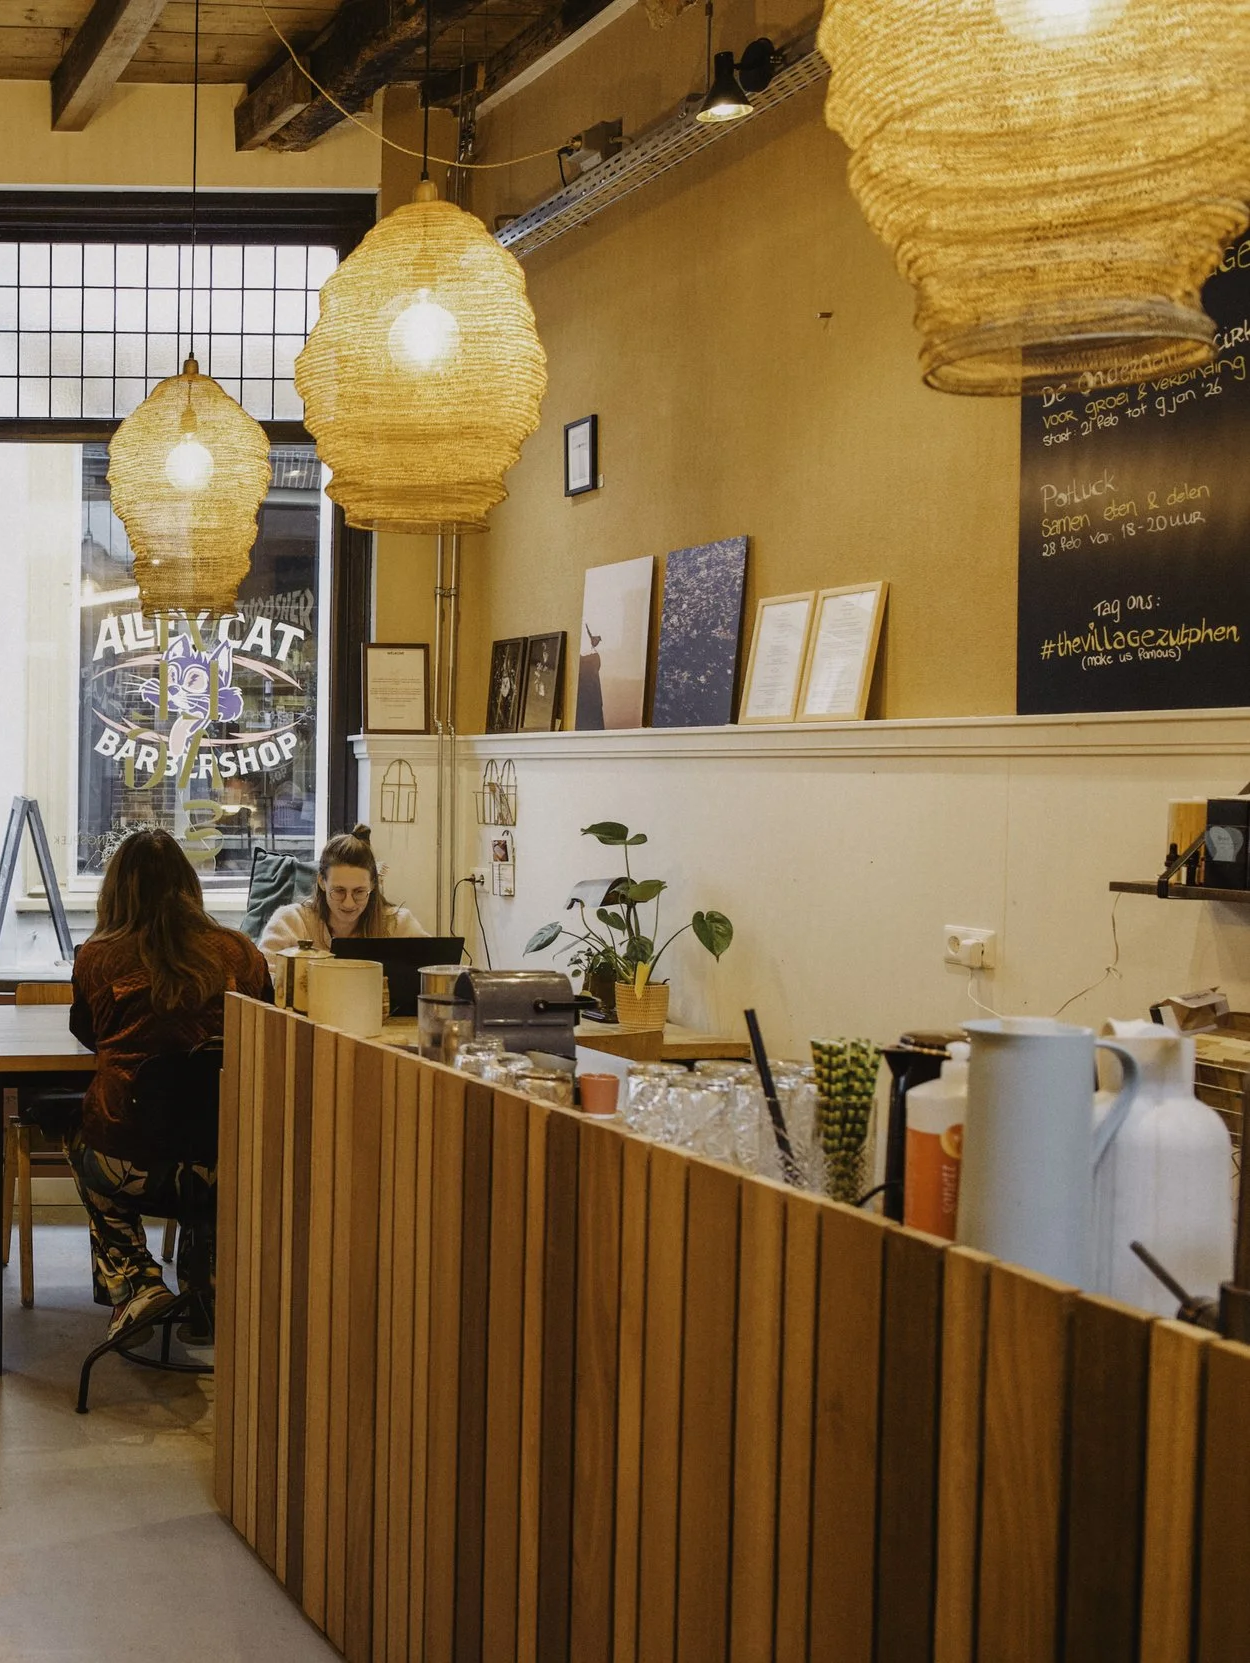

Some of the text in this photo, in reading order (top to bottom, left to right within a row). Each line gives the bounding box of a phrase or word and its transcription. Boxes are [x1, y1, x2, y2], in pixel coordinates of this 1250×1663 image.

[1137, 381, 1149, 401] &
[1097, 414, 1119, 430] feb
[1125, 404, 1148, 418] tot
[1168, 388, 1196, 413] jan
[1042, 483, 1211, 538] Samen eten & delen
[1042, 541, 1056, 557] 28
[1060, 536, 1082, 551] feb
[1090, 532, 1115, 545] van
[1093, 599, 1121, 623] Tag
[1119, 652, 1134, 664] us
